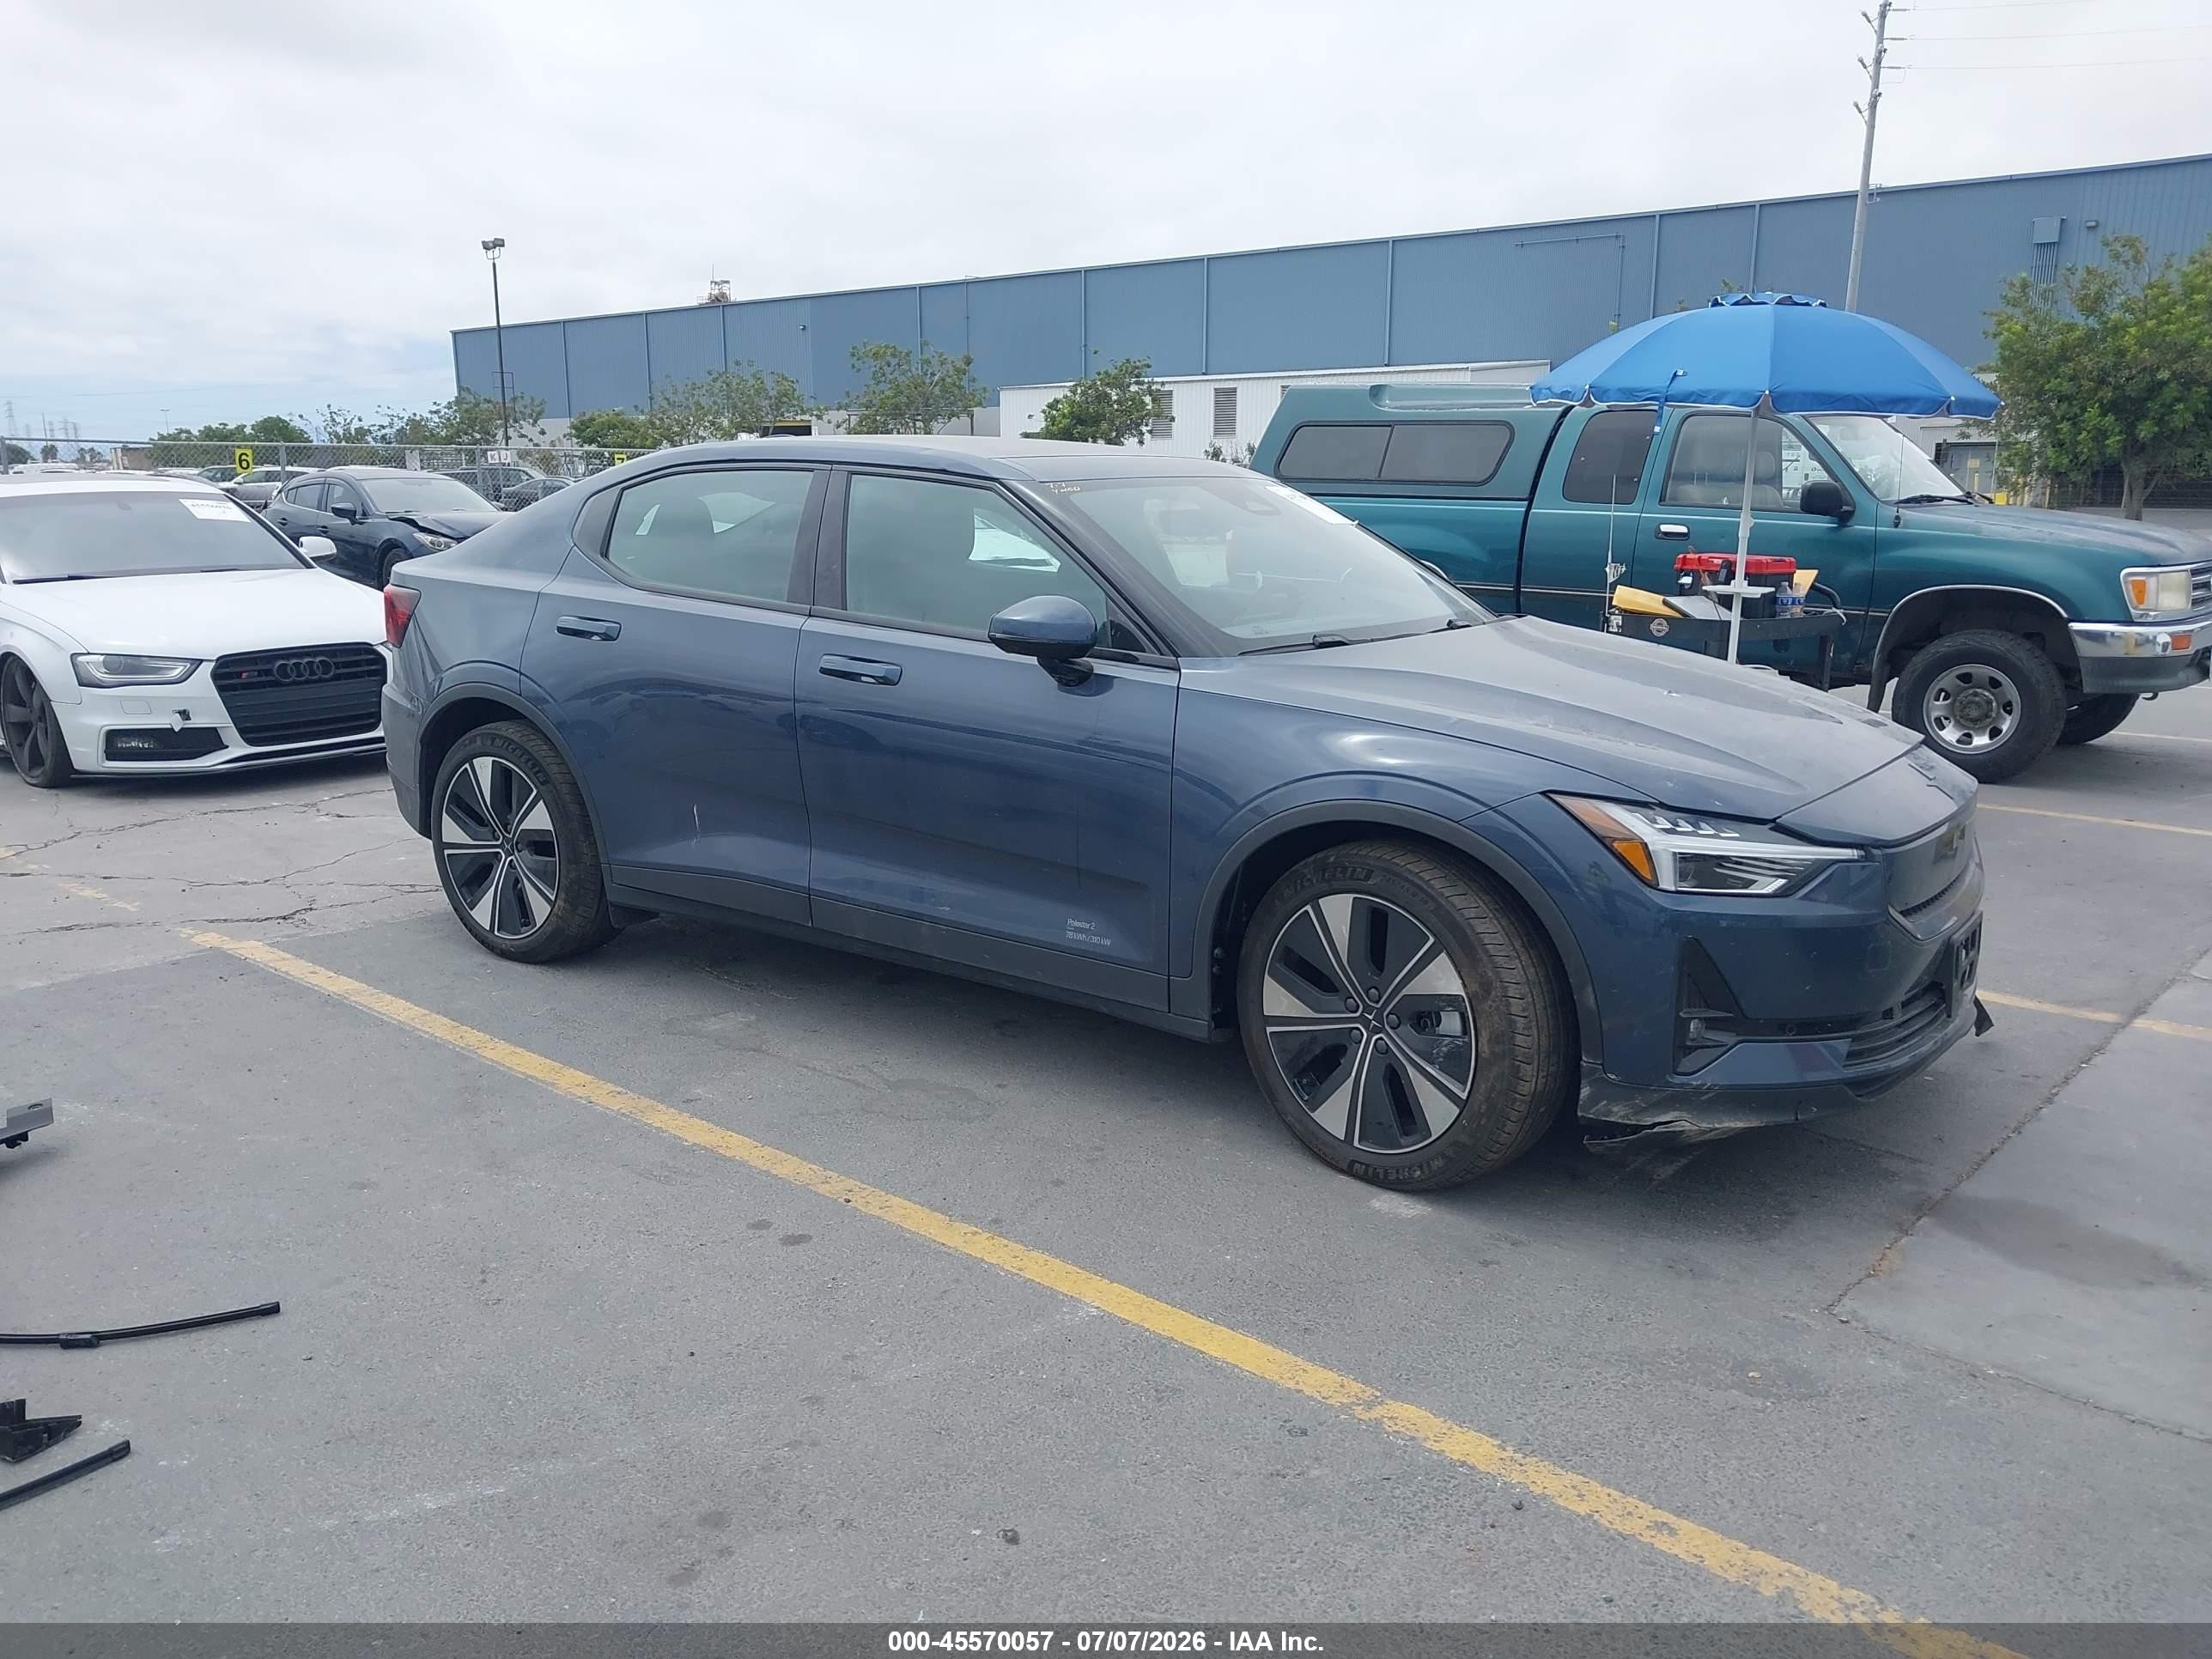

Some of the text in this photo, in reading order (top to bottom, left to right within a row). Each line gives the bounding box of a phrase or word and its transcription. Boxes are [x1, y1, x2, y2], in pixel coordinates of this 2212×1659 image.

[238, 452, 250, 471] 6
[489, 453, 496, 461] K
[502, 453, 508, 461] J
[1066, 918, 1096, 930] Polestar 2
